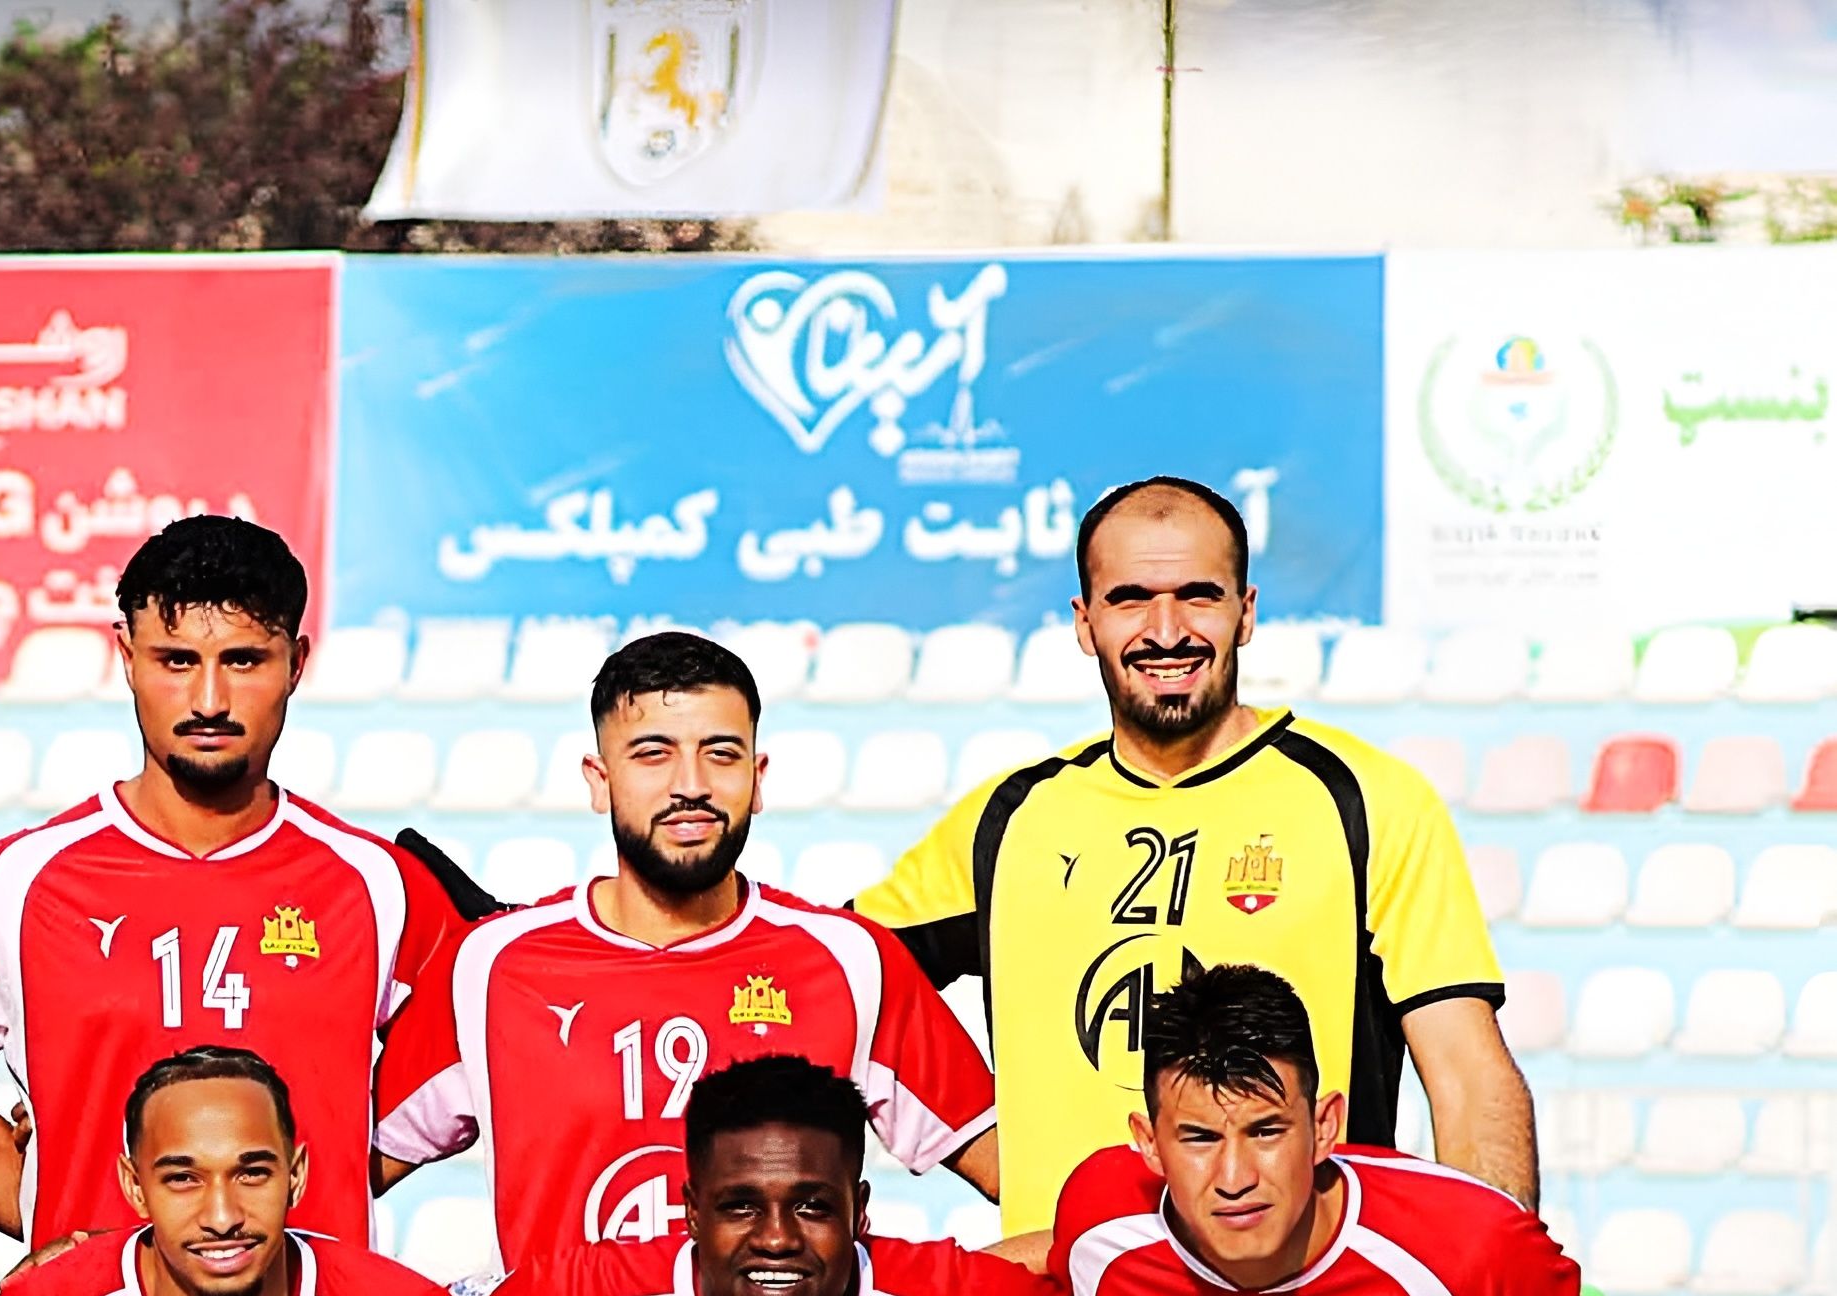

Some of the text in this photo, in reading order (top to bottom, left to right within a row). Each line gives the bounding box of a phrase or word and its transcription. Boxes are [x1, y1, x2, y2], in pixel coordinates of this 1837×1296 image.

[436, 487, 720, 586] کمپلکس
[1110, 826, 1199, 926] 21
[151, 926, 251, 1029] 14
[613, 1015, 709, 1120] 19
